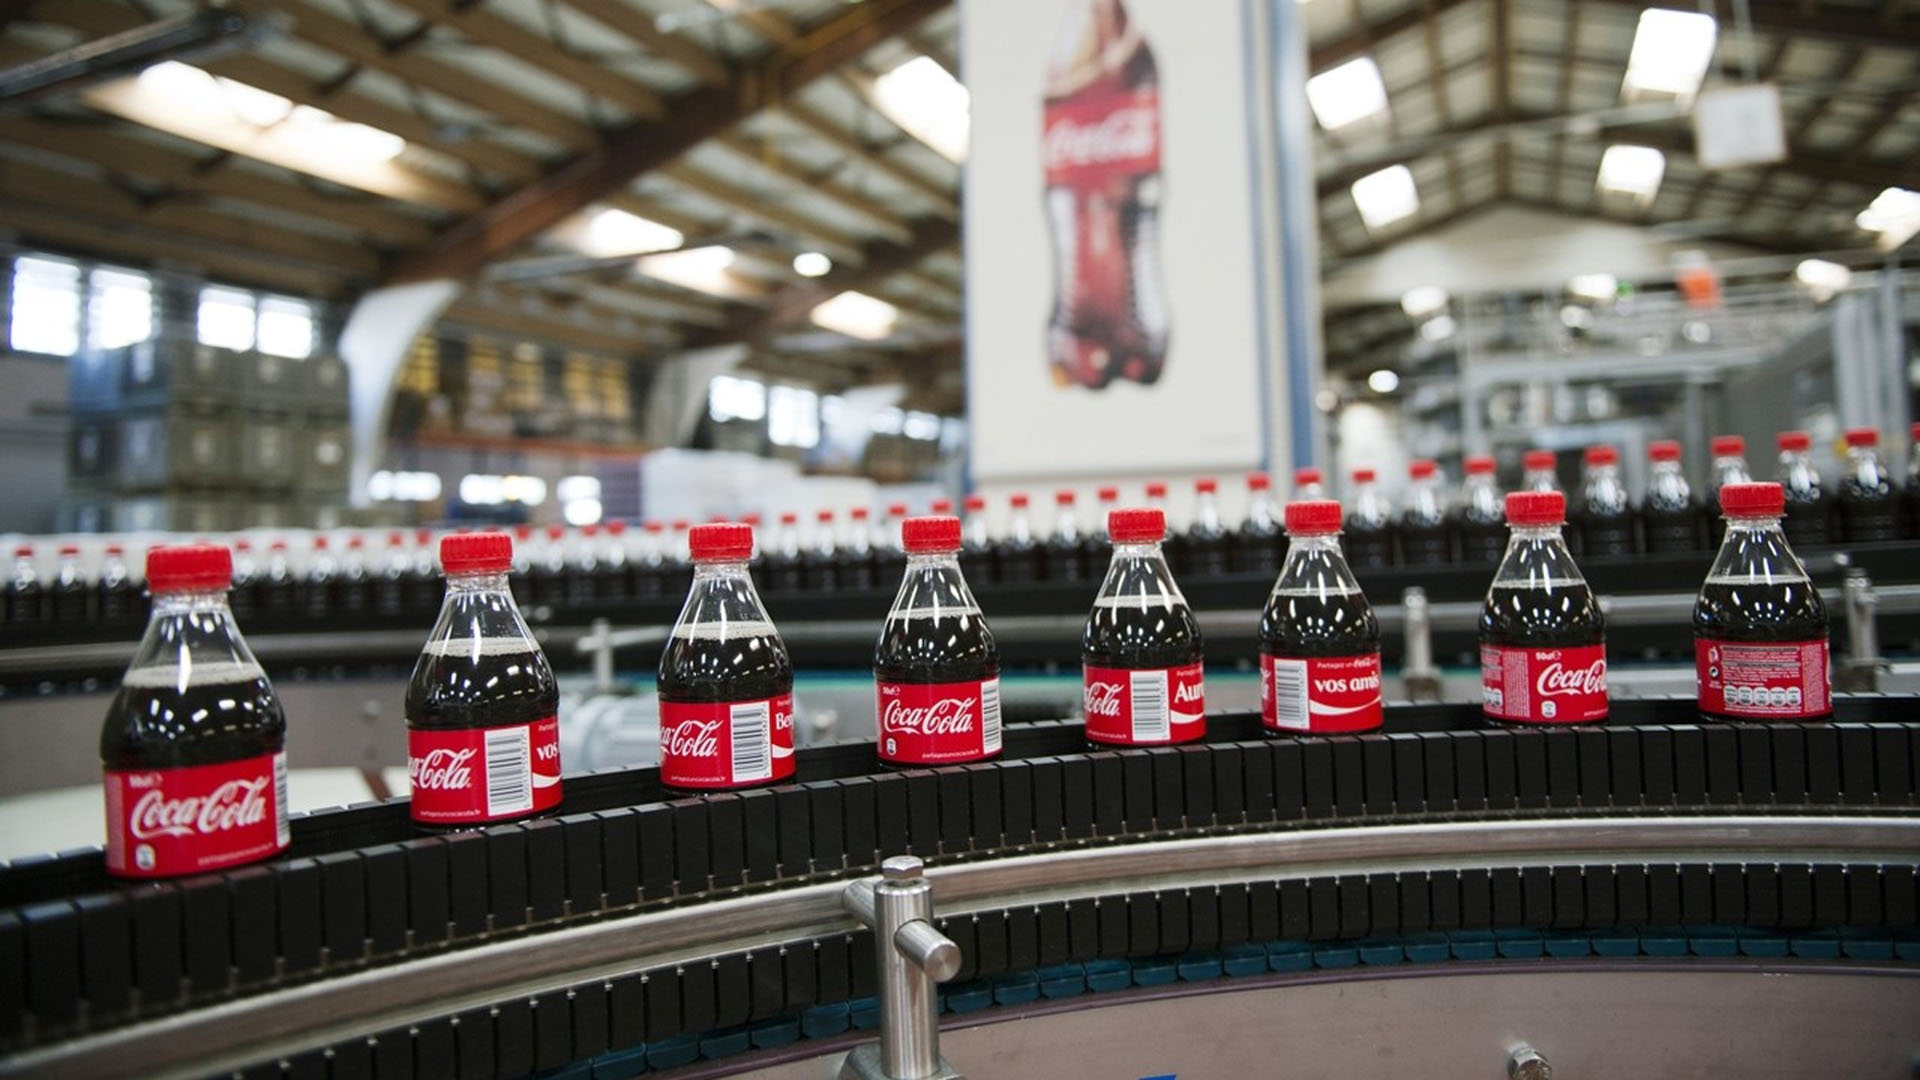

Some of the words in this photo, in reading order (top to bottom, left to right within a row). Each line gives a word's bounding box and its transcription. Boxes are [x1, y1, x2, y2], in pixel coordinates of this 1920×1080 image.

[1314, 679, 1347, 693] vos
[1349, 670, 1379, 692] amis
[884, 697, 977, 736] Coca-Cola
[130, 775, 271, 840] Coca-Cola
